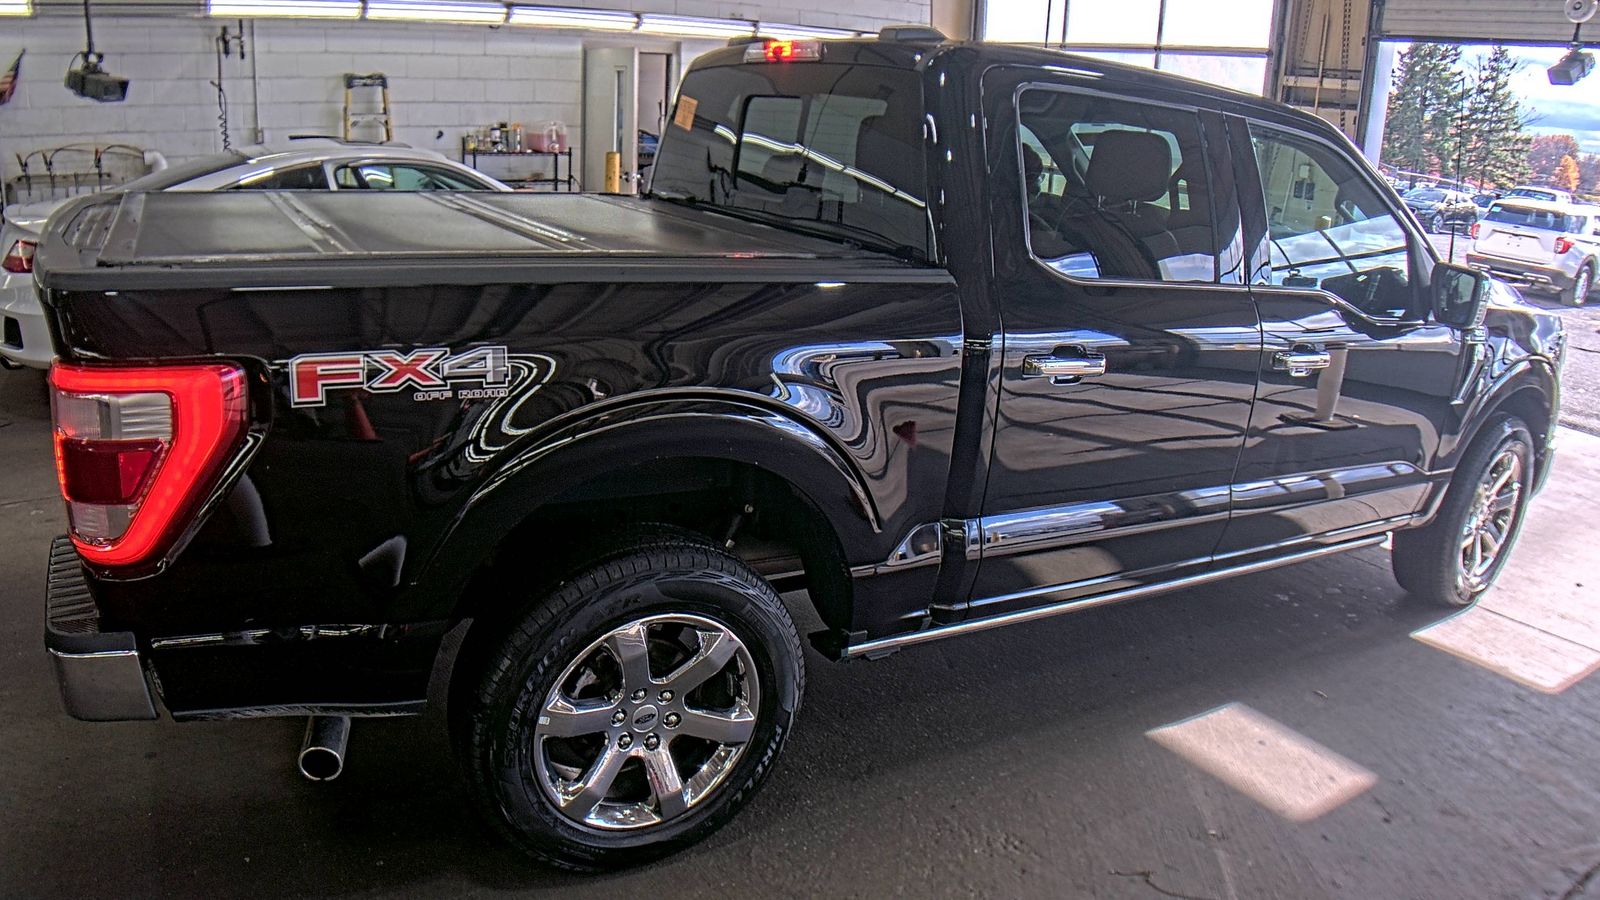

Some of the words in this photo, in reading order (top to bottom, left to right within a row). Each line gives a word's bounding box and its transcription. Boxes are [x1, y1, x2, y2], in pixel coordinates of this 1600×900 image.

[290, 347, 511, 407] FX4
[414, 391, 452, 401] OFF
[458, 388, 509, 399] ROAD
